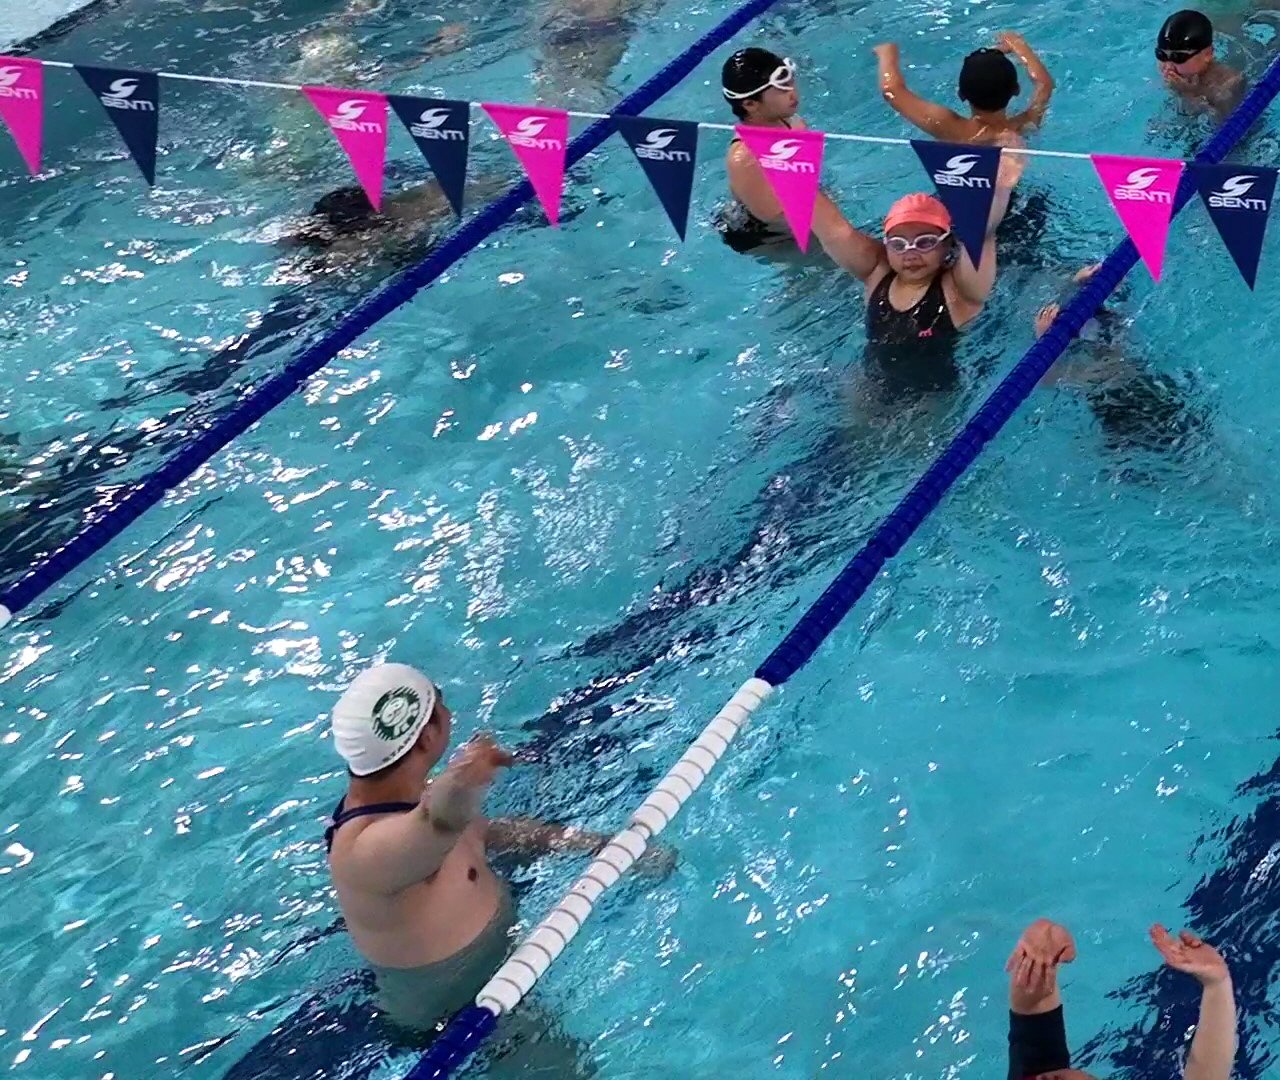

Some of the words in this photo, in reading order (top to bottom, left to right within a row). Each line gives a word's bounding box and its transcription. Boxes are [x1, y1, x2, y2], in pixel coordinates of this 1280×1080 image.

[0, 86, 38, 100] ENTI
[101, 96, 155, 111] SENTI
[329, 118, 383, 134] SENTI
[411, 125, 465, 141] SENTI
[507, 134, 562, 151] SENTI
[635, 146, 690, 162] SENTI
[759, 156, 815, 174] SENTI
[934, 172, 991, 189] SENTI
[1113, 186, 1171, 204] SENTI
[1208, 194, 1267, 211] SENTI
